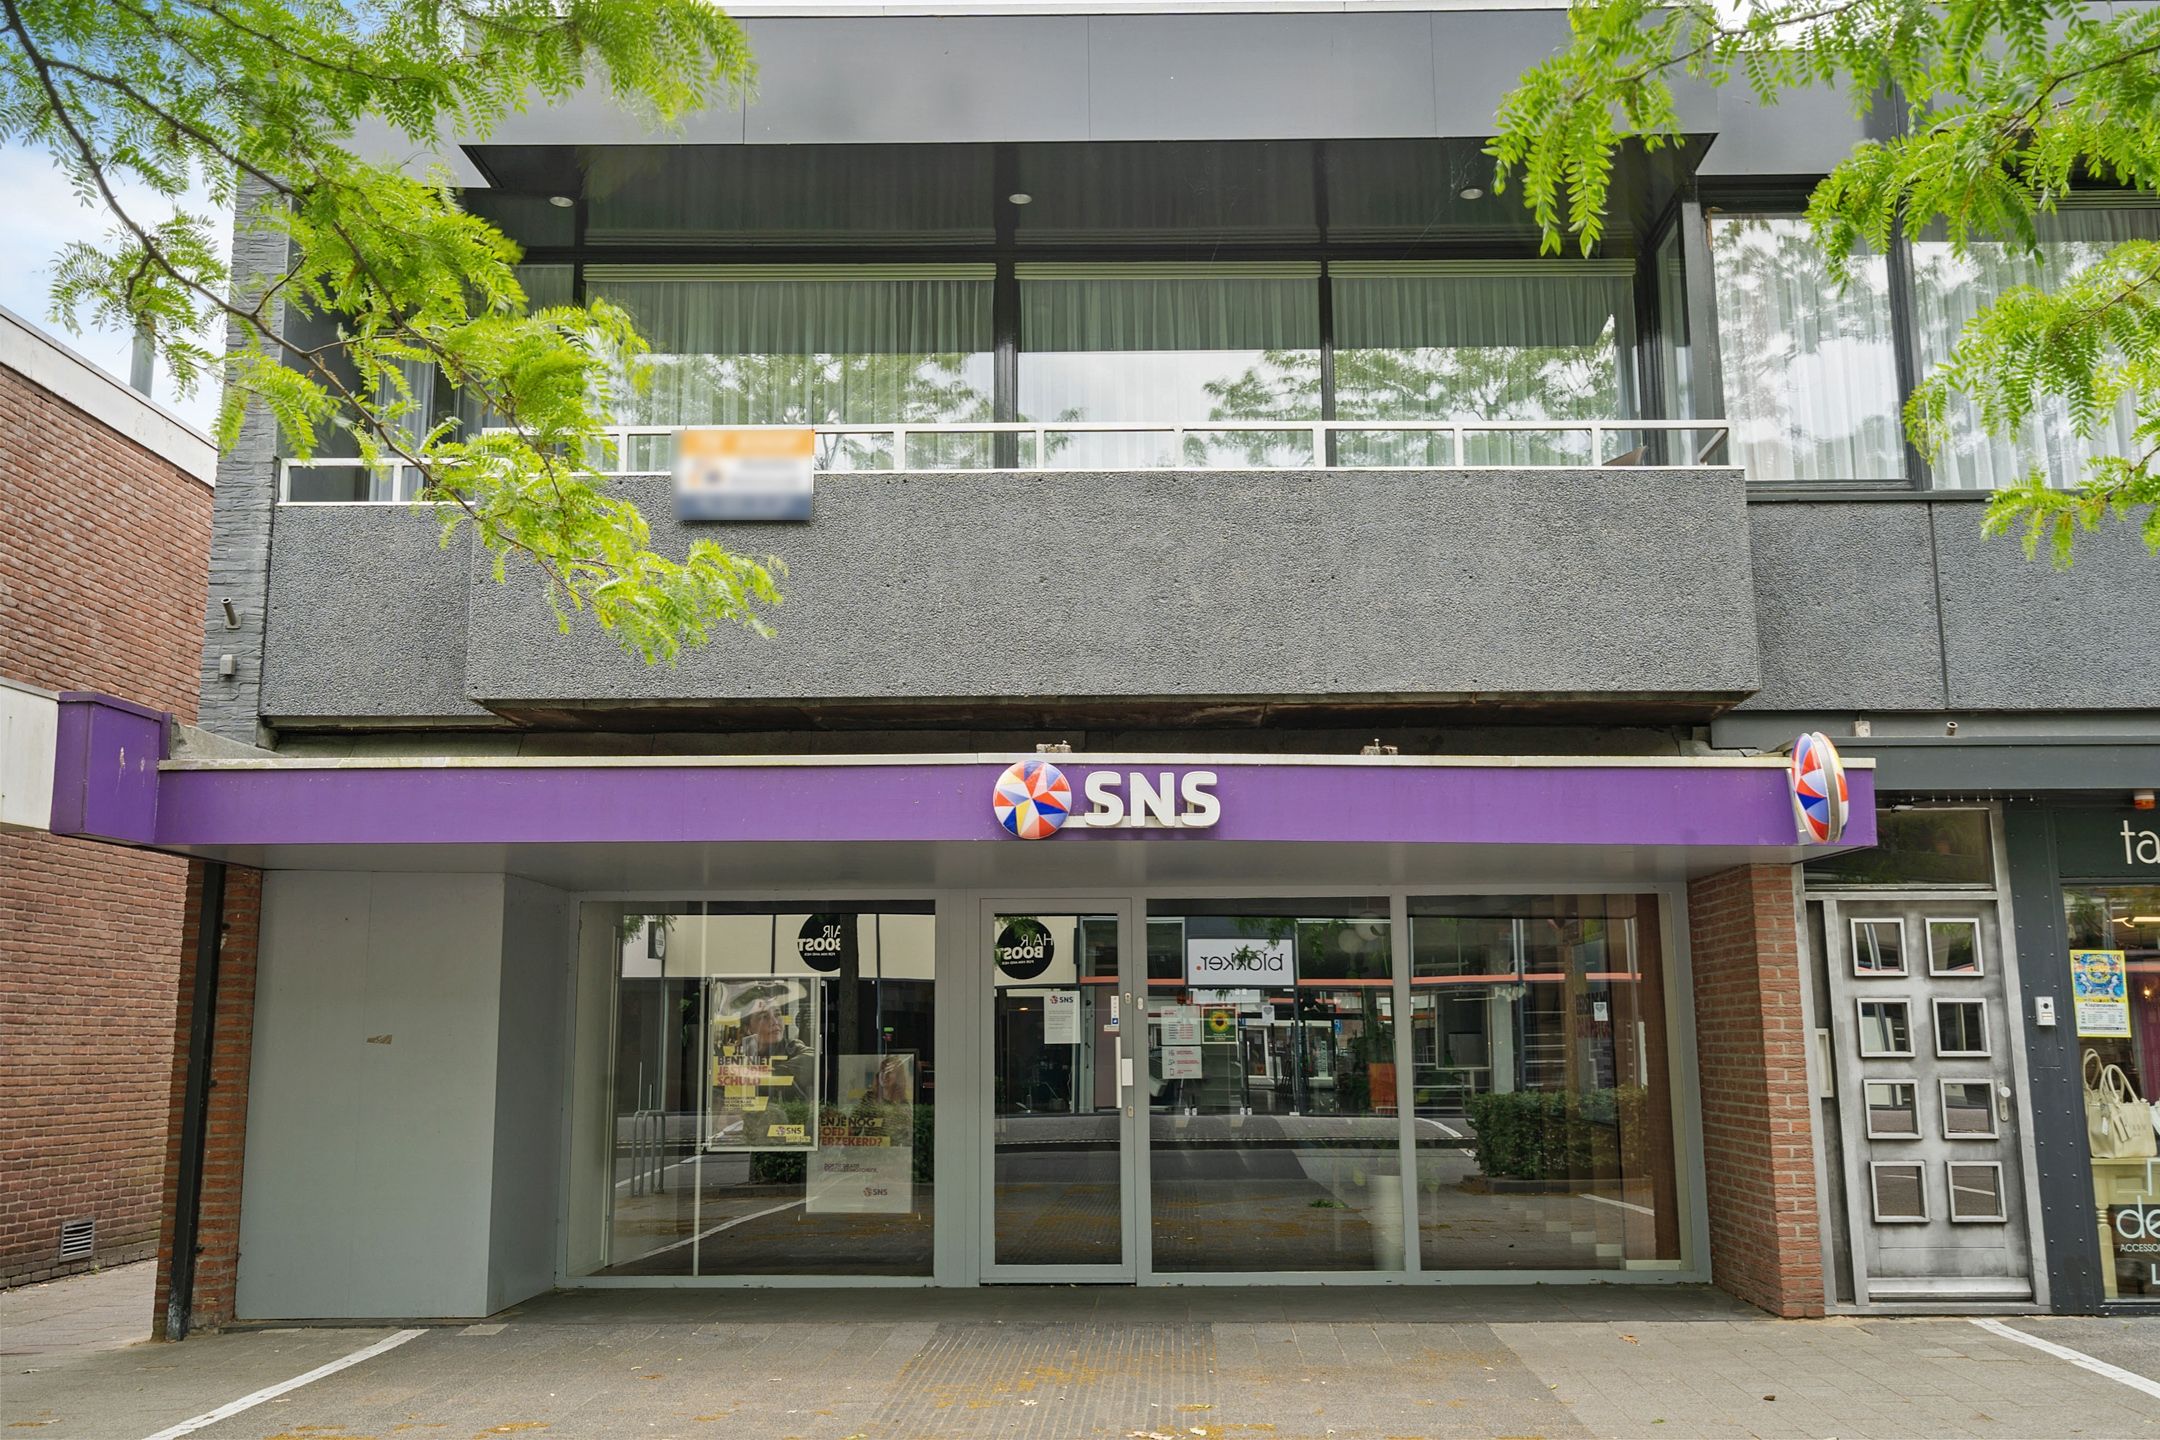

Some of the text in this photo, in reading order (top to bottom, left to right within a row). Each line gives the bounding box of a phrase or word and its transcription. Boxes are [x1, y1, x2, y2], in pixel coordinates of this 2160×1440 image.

[1084, 770, 1221, 827] SNS
[2120, 820, 2160, 864] ta
[1059, 996, 1074, 1004] SNS
[718, 1056, 745, 1066] BENT
[848, 1117, 876, 1127] NOG
[785, 1127, 802, 1135] SNS
[873, 1188, 888, 1196] SNS
